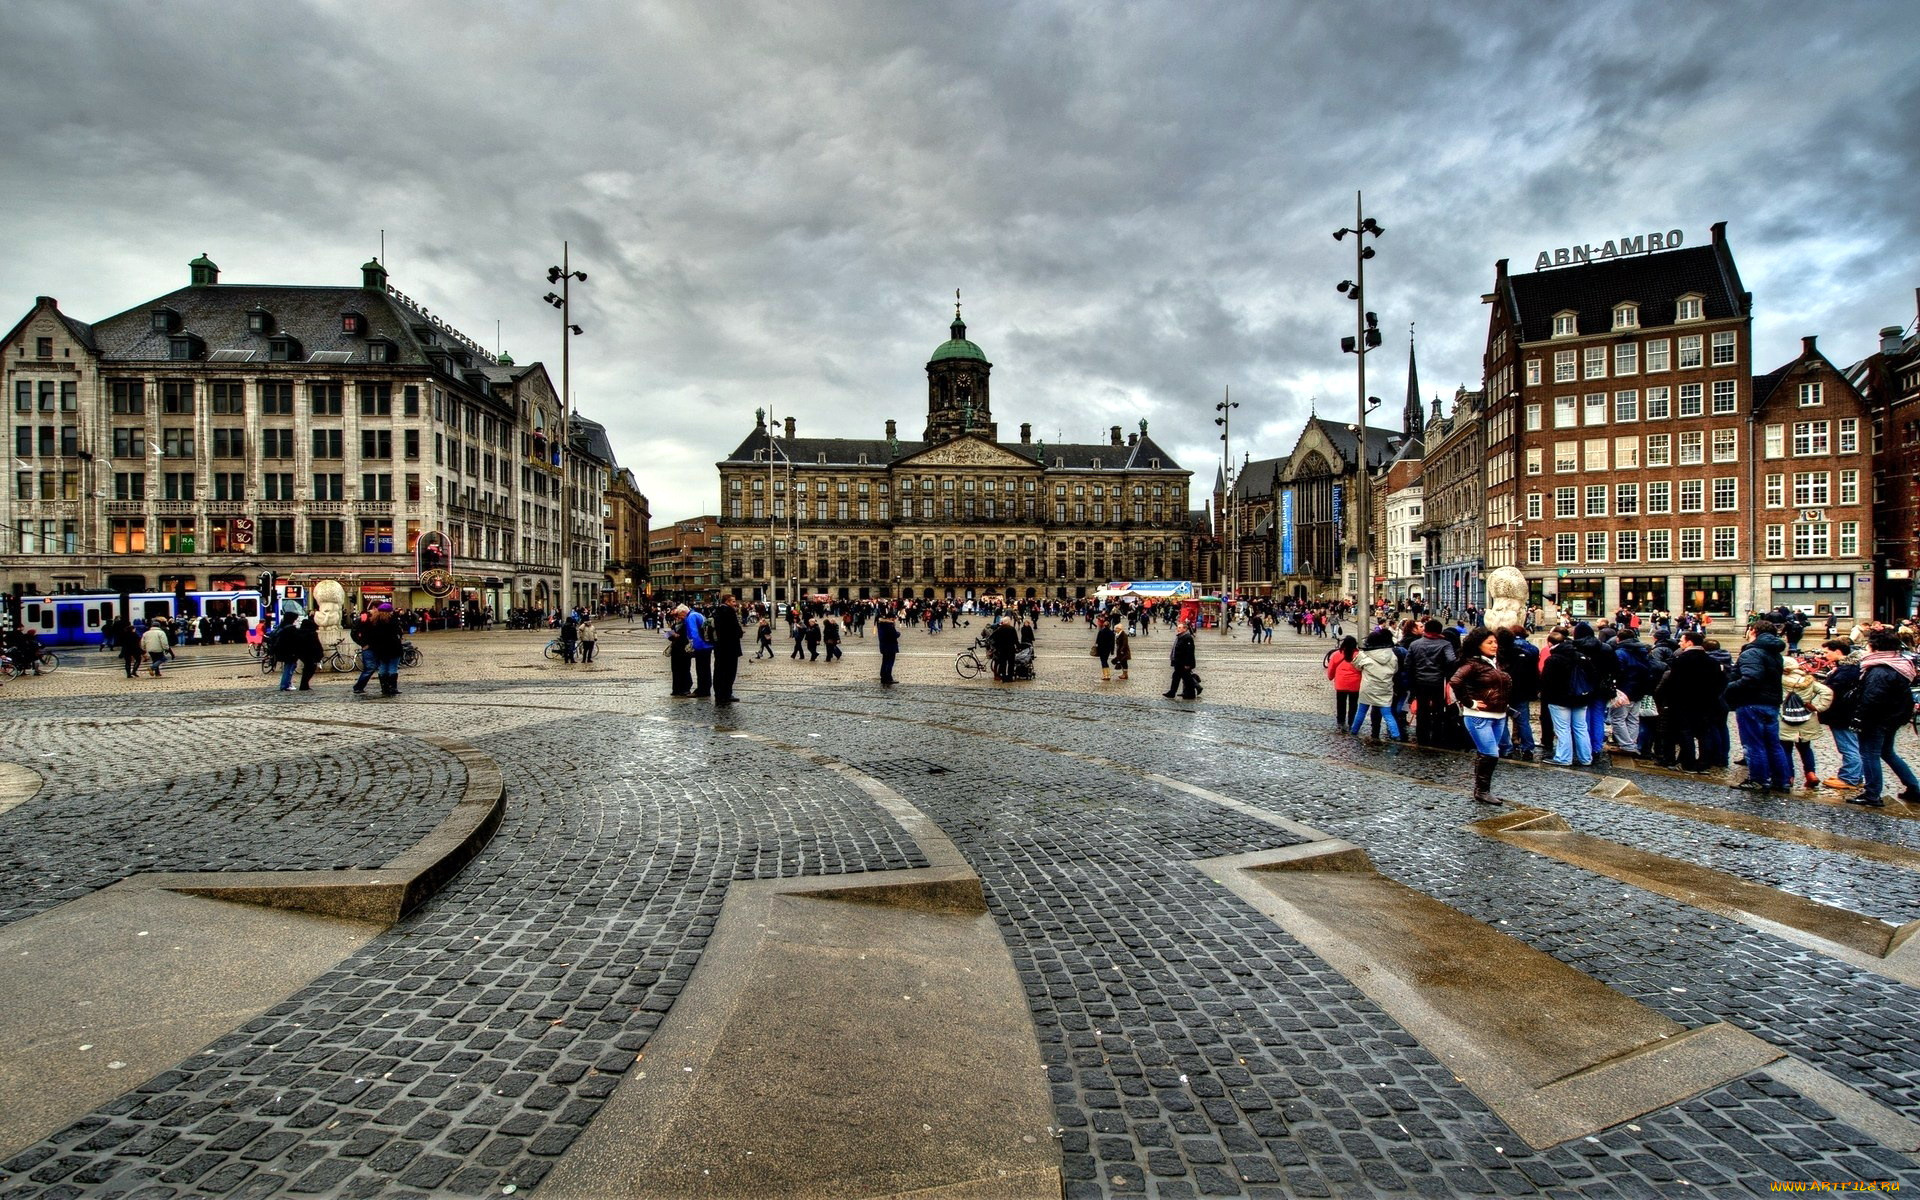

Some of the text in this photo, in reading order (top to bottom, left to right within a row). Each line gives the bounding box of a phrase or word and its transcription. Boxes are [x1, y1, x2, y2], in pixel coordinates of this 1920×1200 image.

[1535, 229, 1684, 270] ABN AMRO
[386, 284, 499, 365] PEEK & CLOPPENBUR
[1282, 494, 1290, 537] Jodendom
[1333, 486, 1342, 522] Judaism
